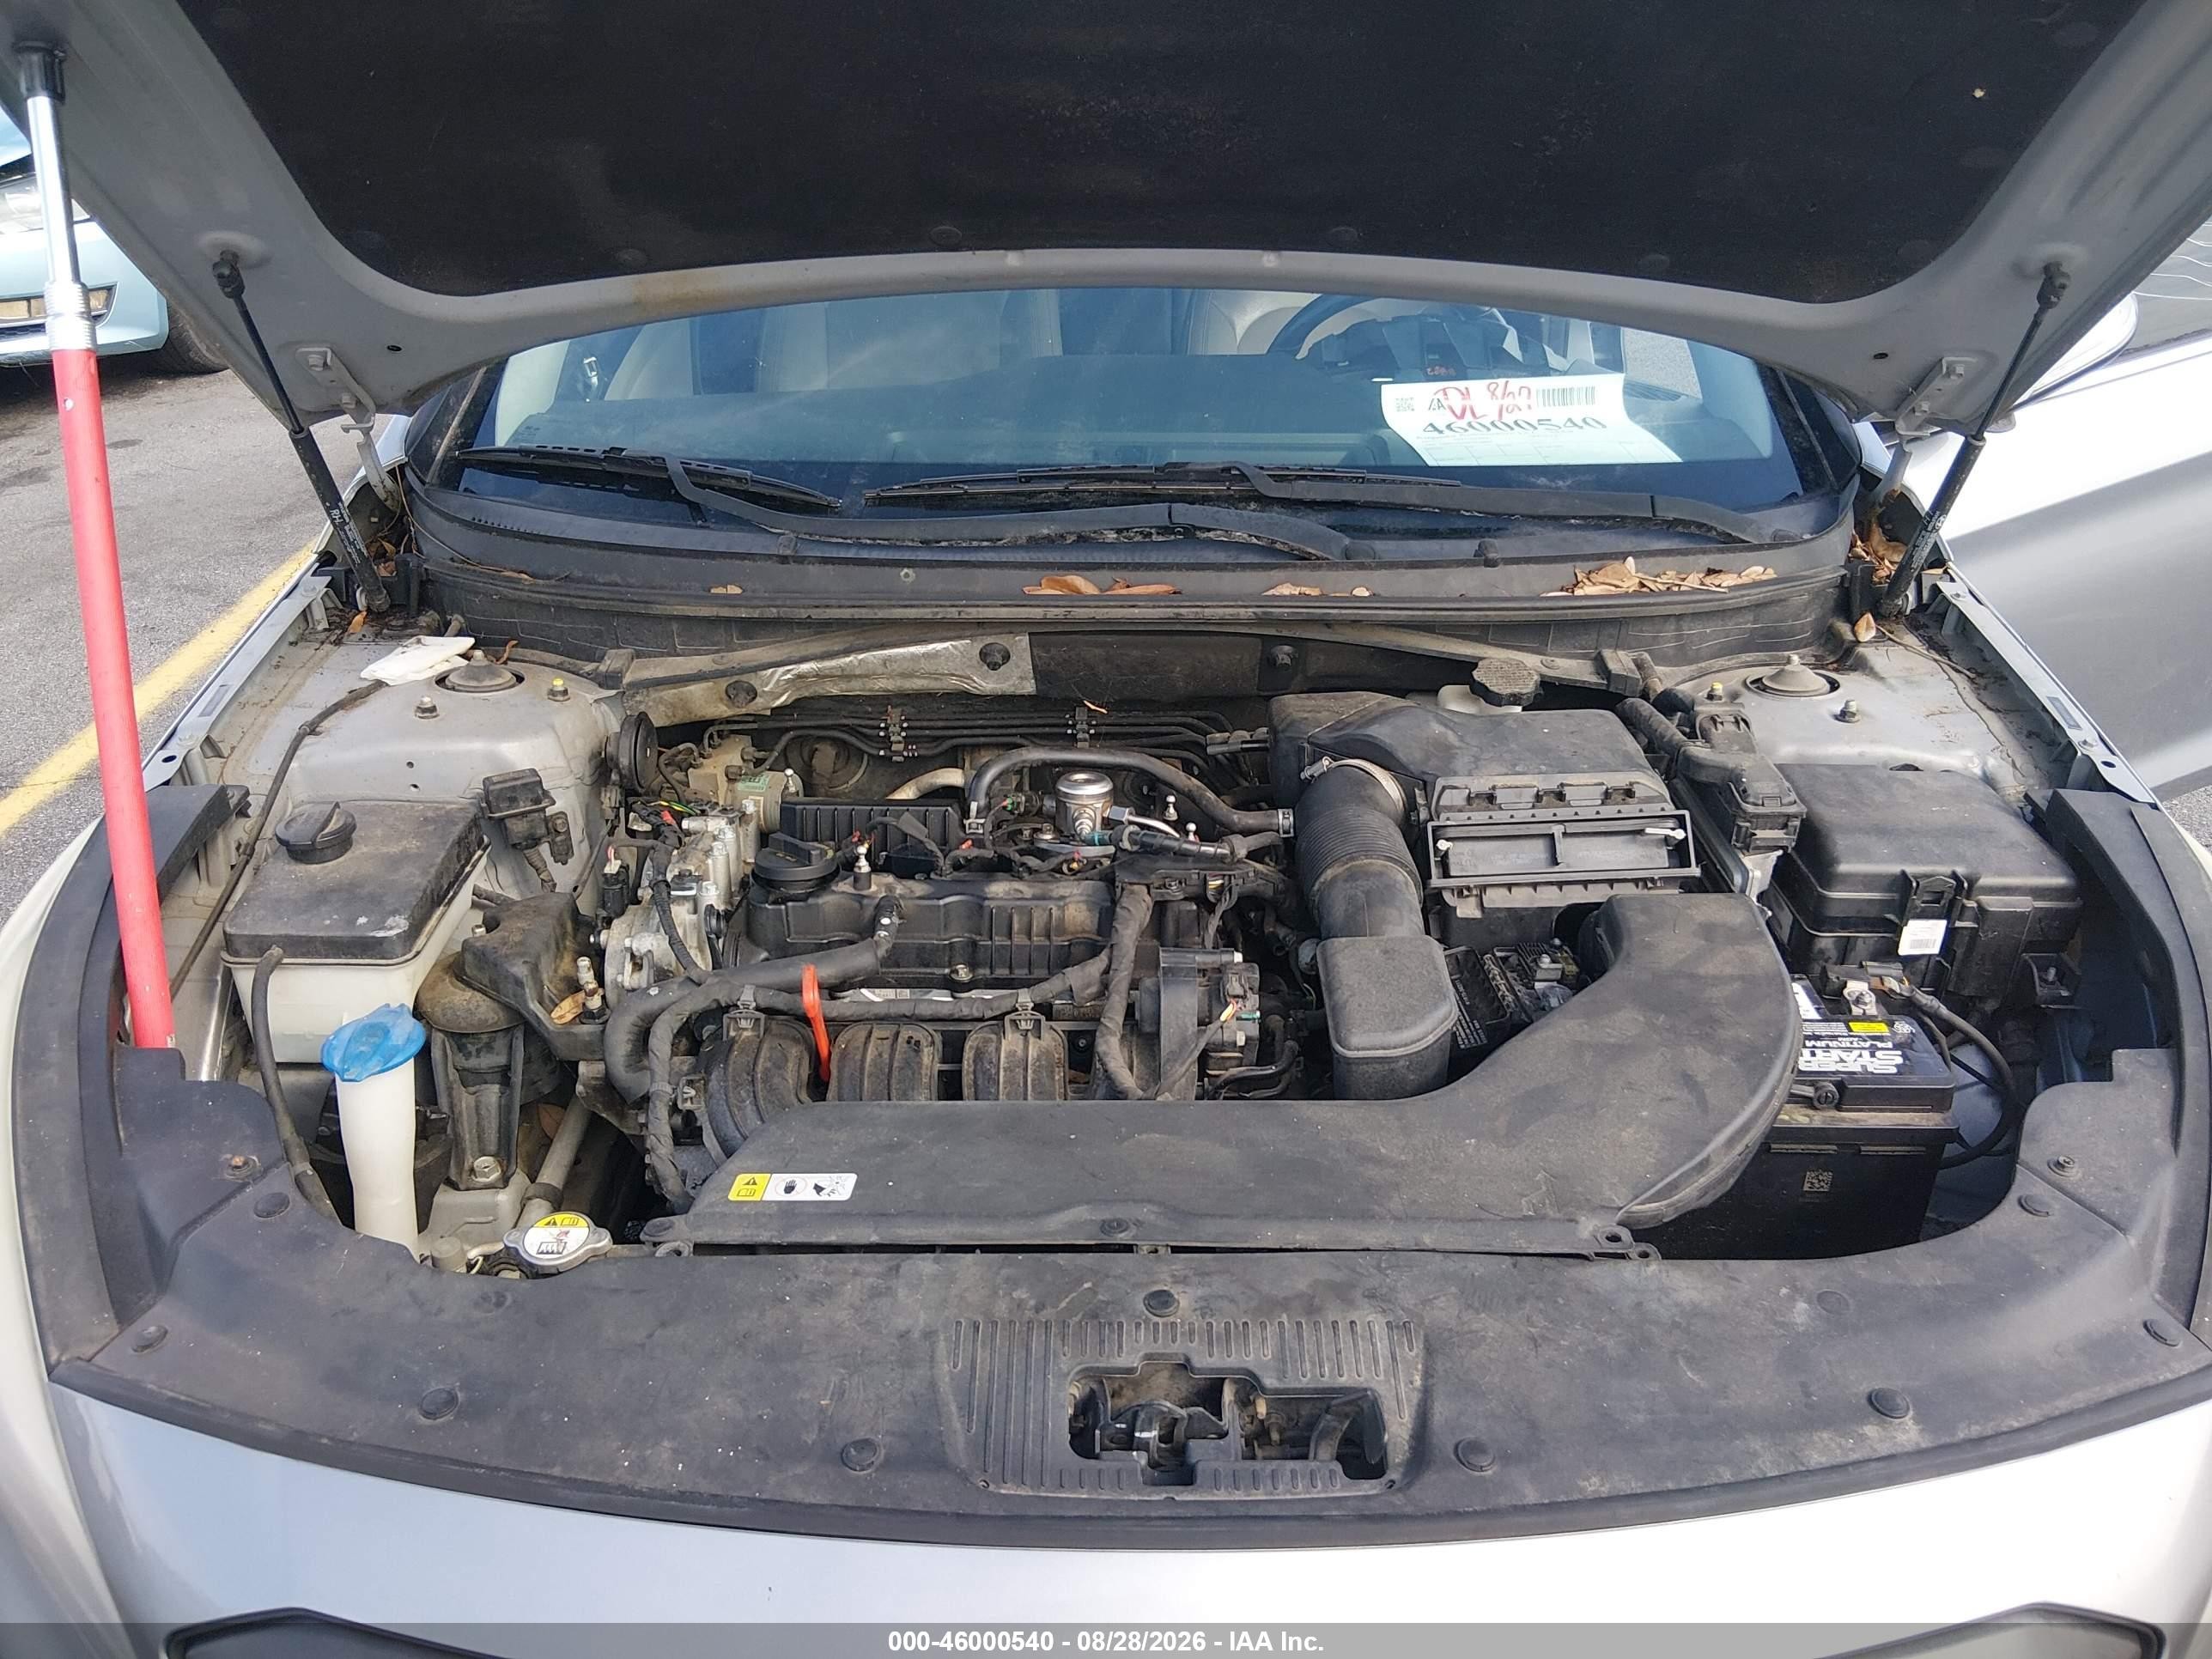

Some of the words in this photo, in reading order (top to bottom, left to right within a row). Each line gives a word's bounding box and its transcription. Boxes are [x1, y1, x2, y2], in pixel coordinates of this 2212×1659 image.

[1423, 416, 1607, 434] 46000540
[1805, 1040, 1893, 1048] PLATINUM
[1801, 1048, 1903, 1065] START
[1799, 1057, 1897, 1073] SUPER
